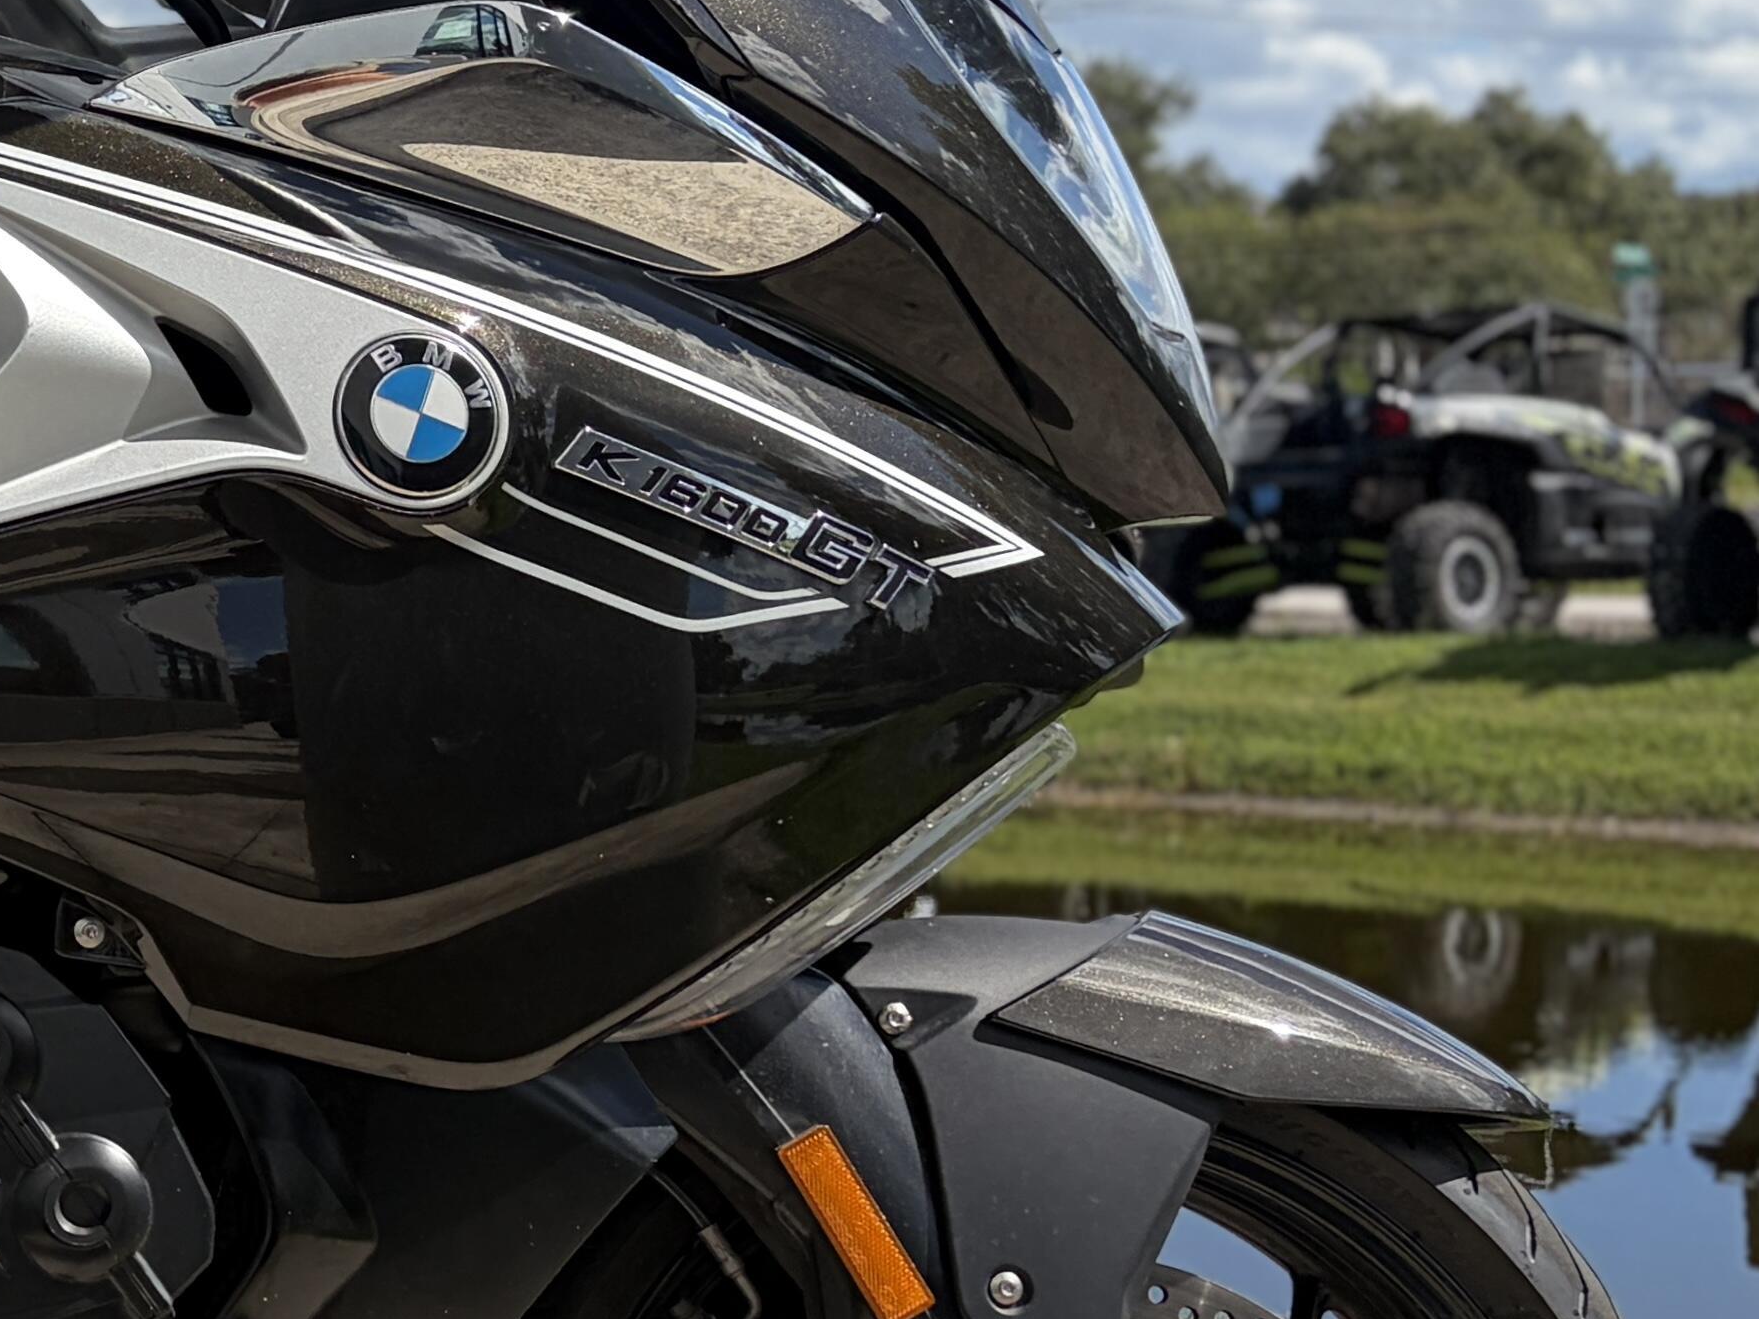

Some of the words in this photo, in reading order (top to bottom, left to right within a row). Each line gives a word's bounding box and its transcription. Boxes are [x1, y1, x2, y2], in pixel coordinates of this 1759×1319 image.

[370, 341, 492, 409] BMW
[577, 441, 639, 485] K
[639, 465, 790, 548] 1600
[789, 510, 935, 610] GT
